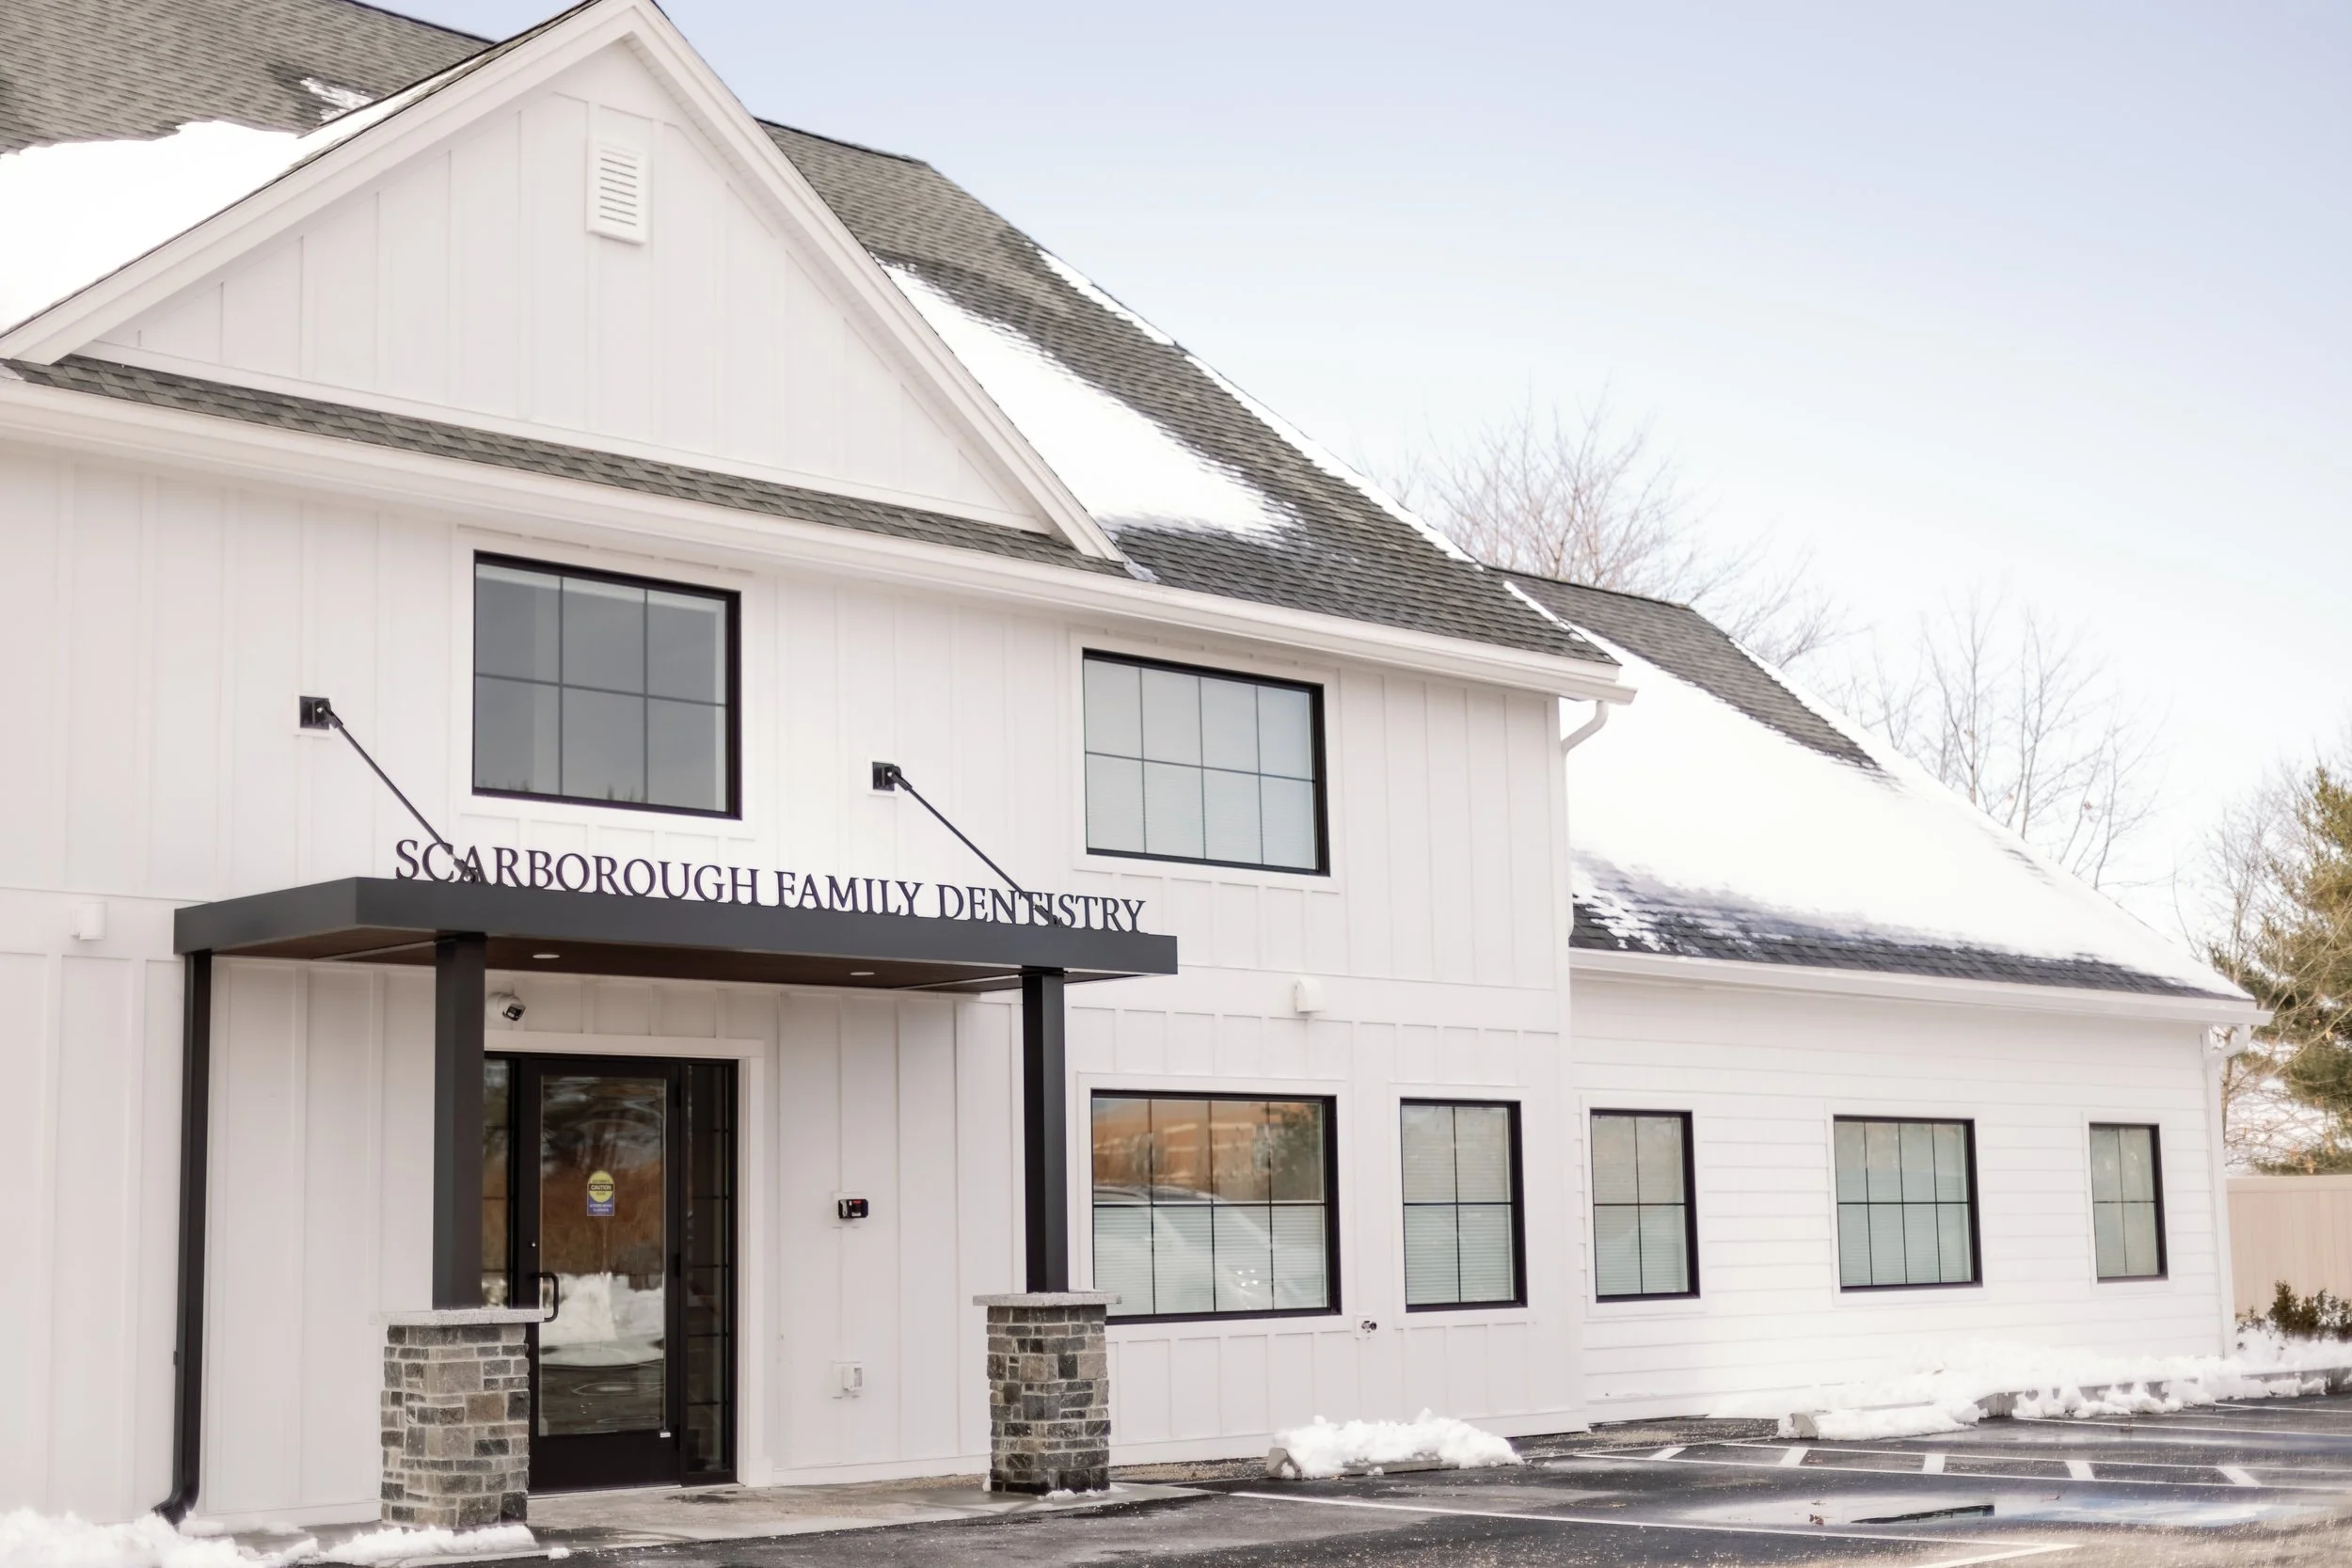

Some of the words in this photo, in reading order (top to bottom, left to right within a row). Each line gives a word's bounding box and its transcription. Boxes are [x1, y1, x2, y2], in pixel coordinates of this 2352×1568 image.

[395, 839, 761, 905] SCARBOROUGH
[775, 871, 922, 916] FAMILY
[936, 884, 1147, 934] DENTISTRY
